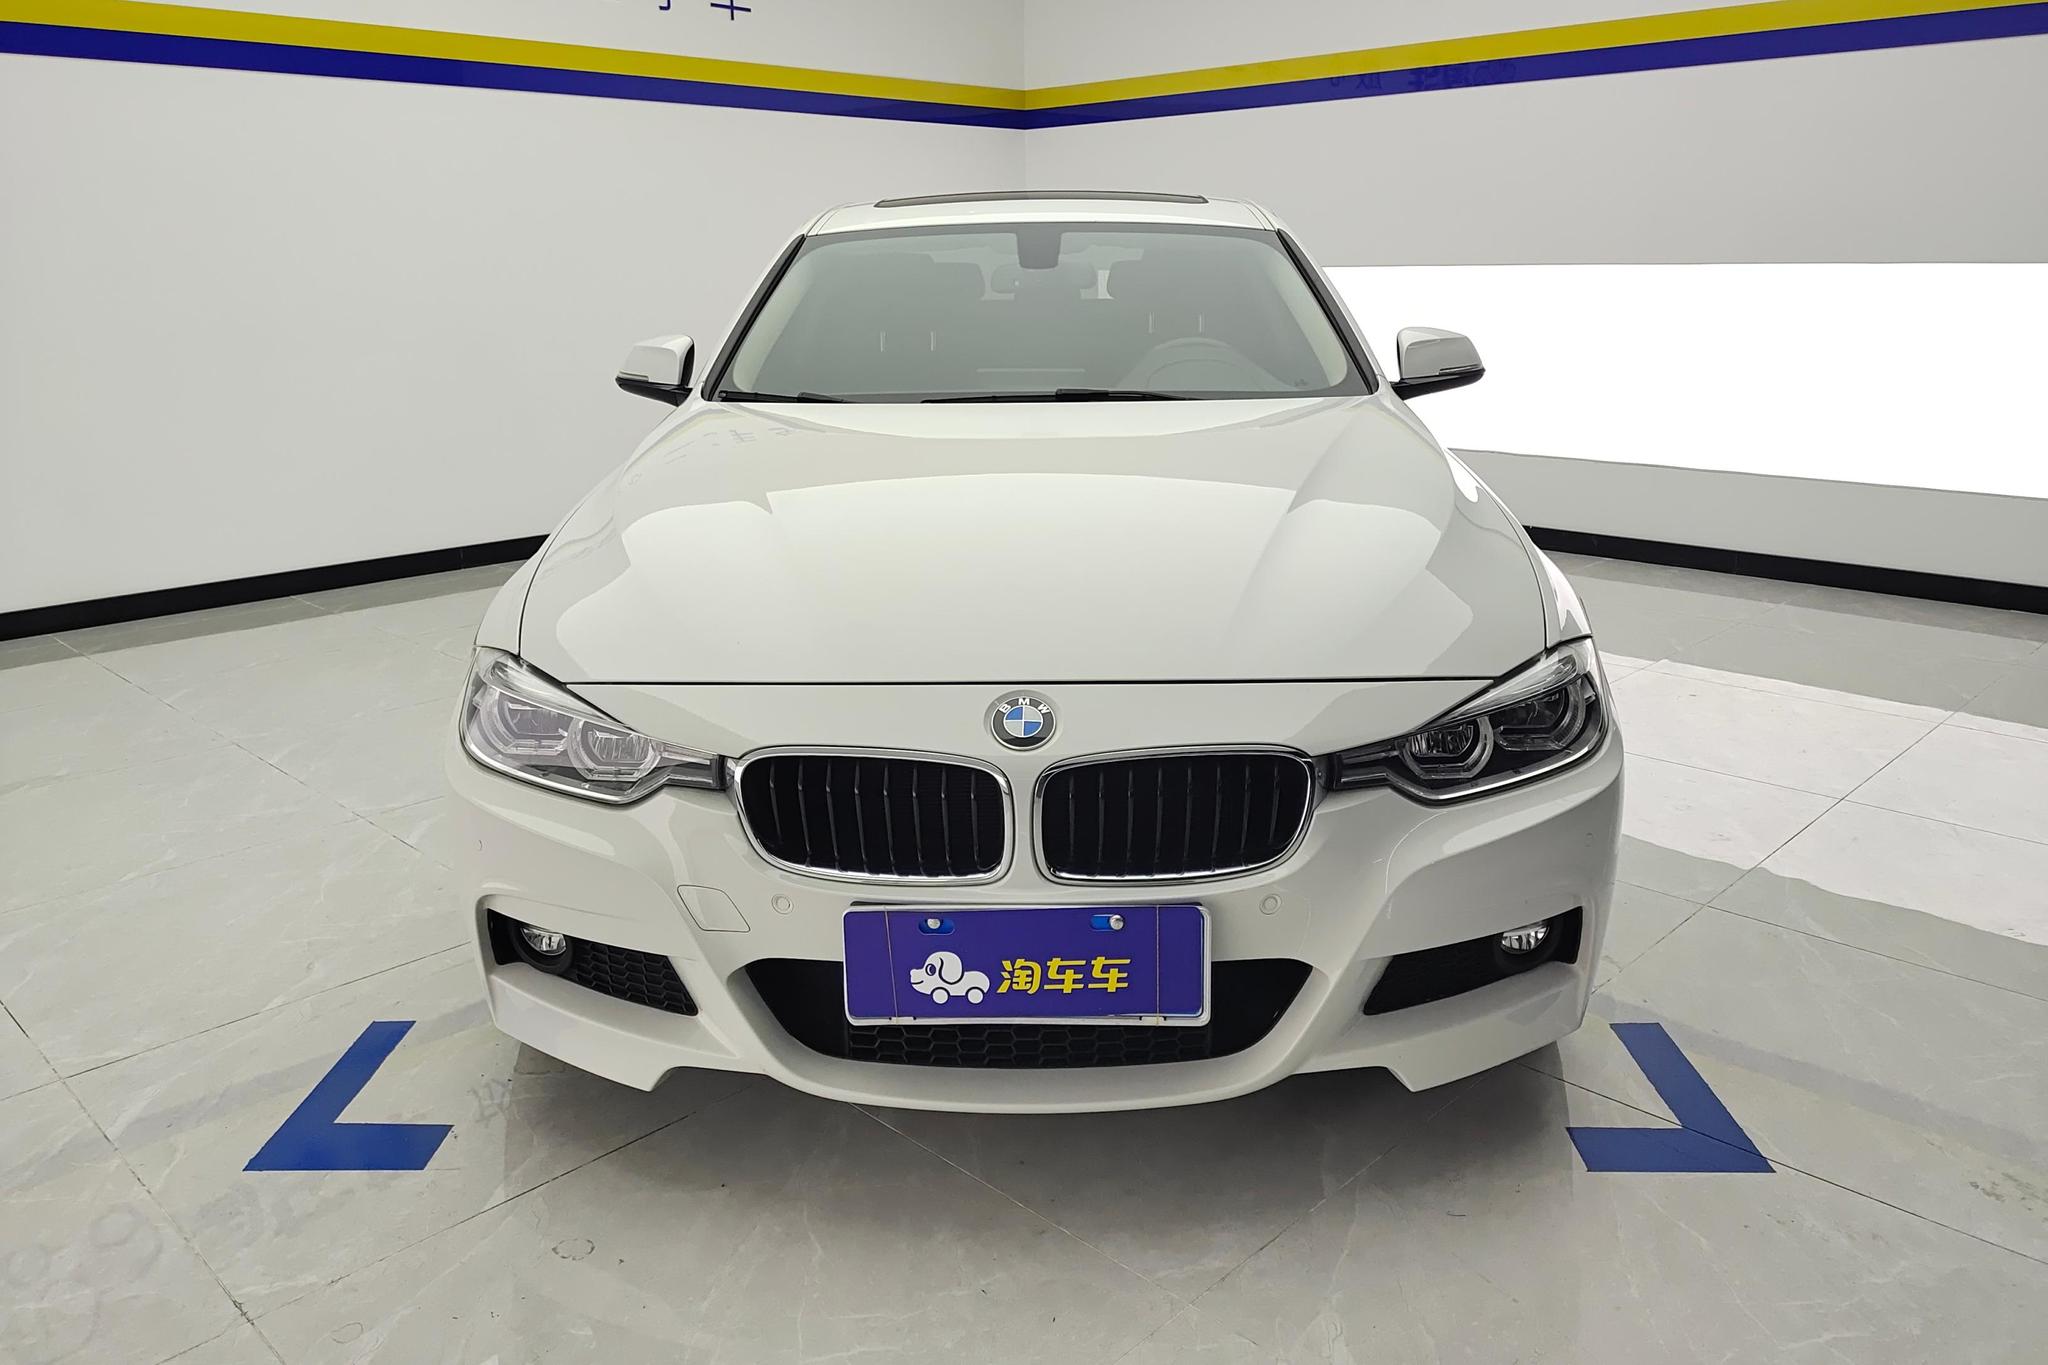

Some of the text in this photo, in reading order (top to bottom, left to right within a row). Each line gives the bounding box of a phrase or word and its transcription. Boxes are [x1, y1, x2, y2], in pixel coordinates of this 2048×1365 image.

[999, 697, 1051, 714] BMW
[996, 956, 1131, 995] 淘车车
